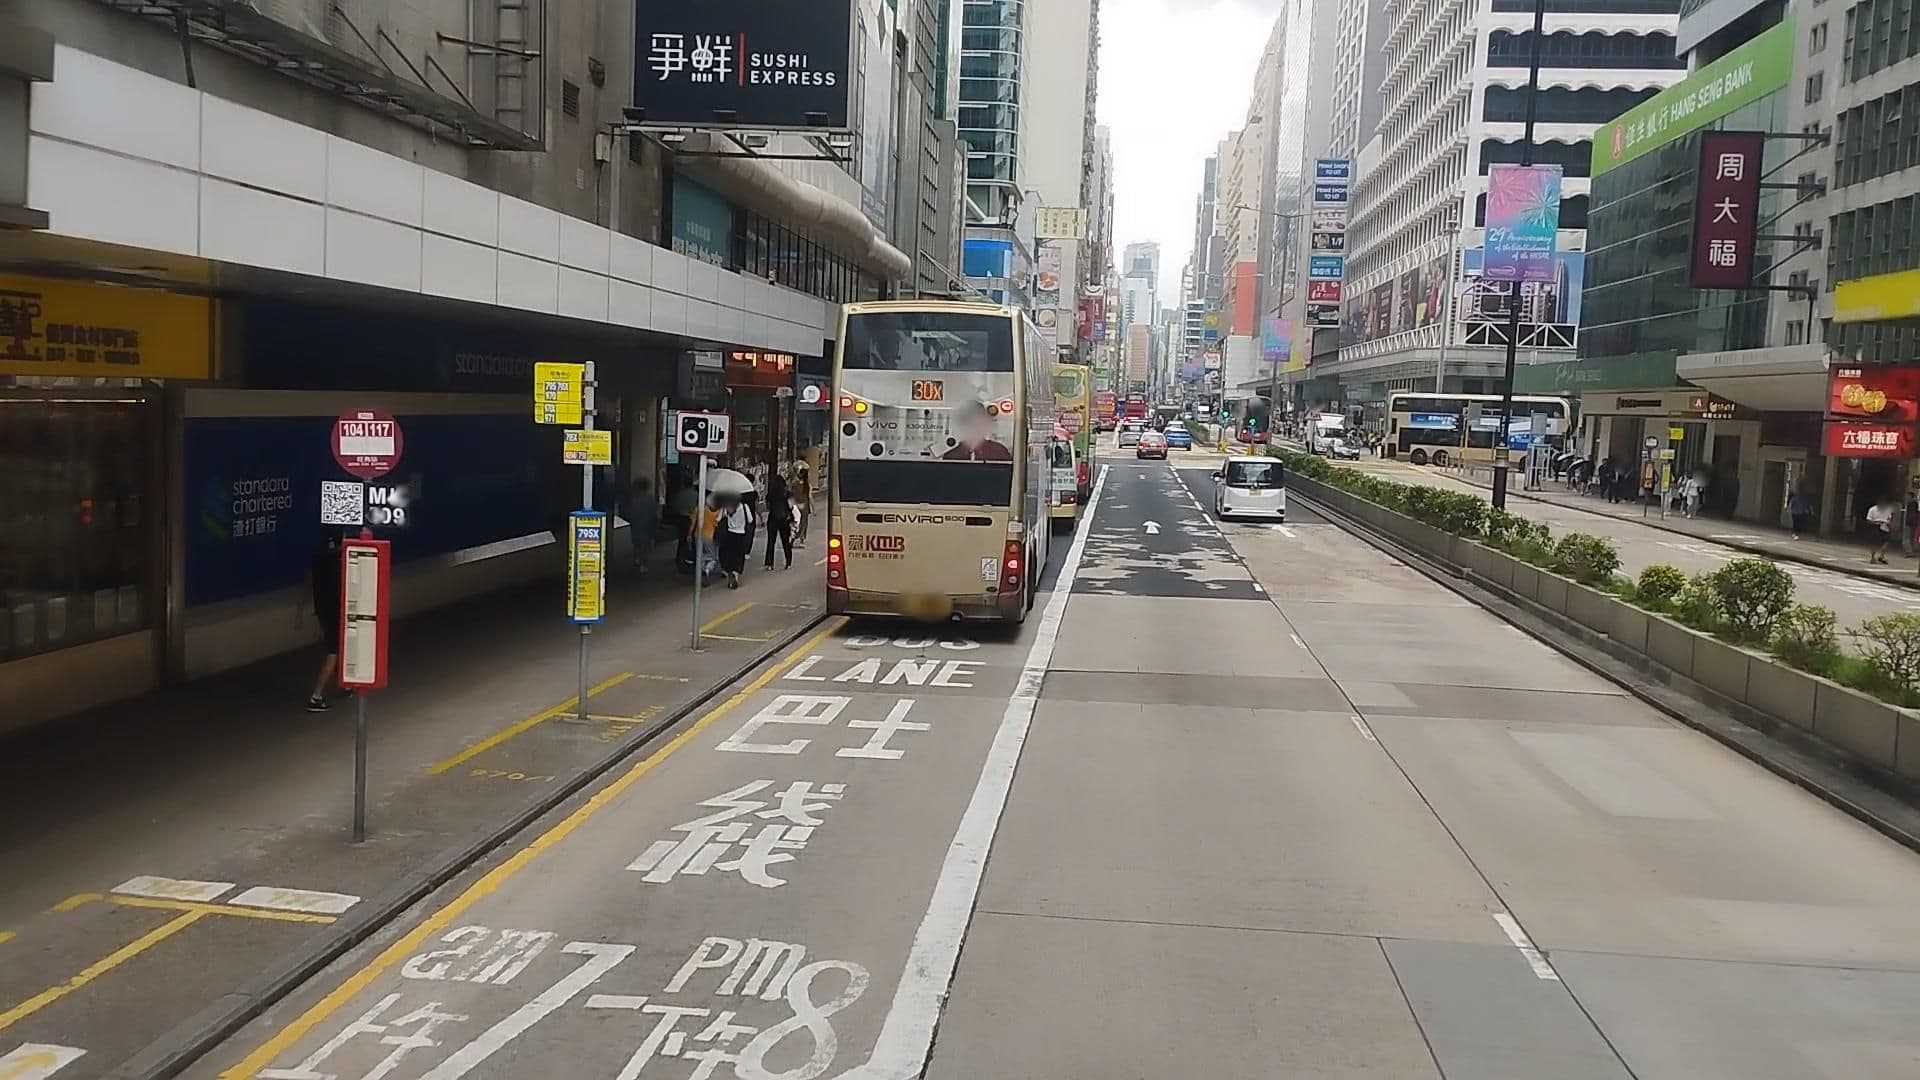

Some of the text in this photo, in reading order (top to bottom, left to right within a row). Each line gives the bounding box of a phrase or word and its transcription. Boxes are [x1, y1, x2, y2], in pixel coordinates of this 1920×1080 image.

[750, 53, 808, 68] SUSHI
[750, 71, 836, 86] EXPRESS
[1670, 93, 1697, 122] HANG
[1697, 78, 1723, 109] SENG
[1724, 62, 1753, 94] BANK
[1709, 153, 1745, 267] 周大福
[343, 423, 390, 437] 104 117
[866, 419, 898, 429] vivo
[884, 514, 944, 524] ENVIRO
[577, 528, 600, 539] 795X
[866, 535, 905, 552] KMB
[782, 655, 987, 688] LANE
[714, 694, 932, 760] 巴士
